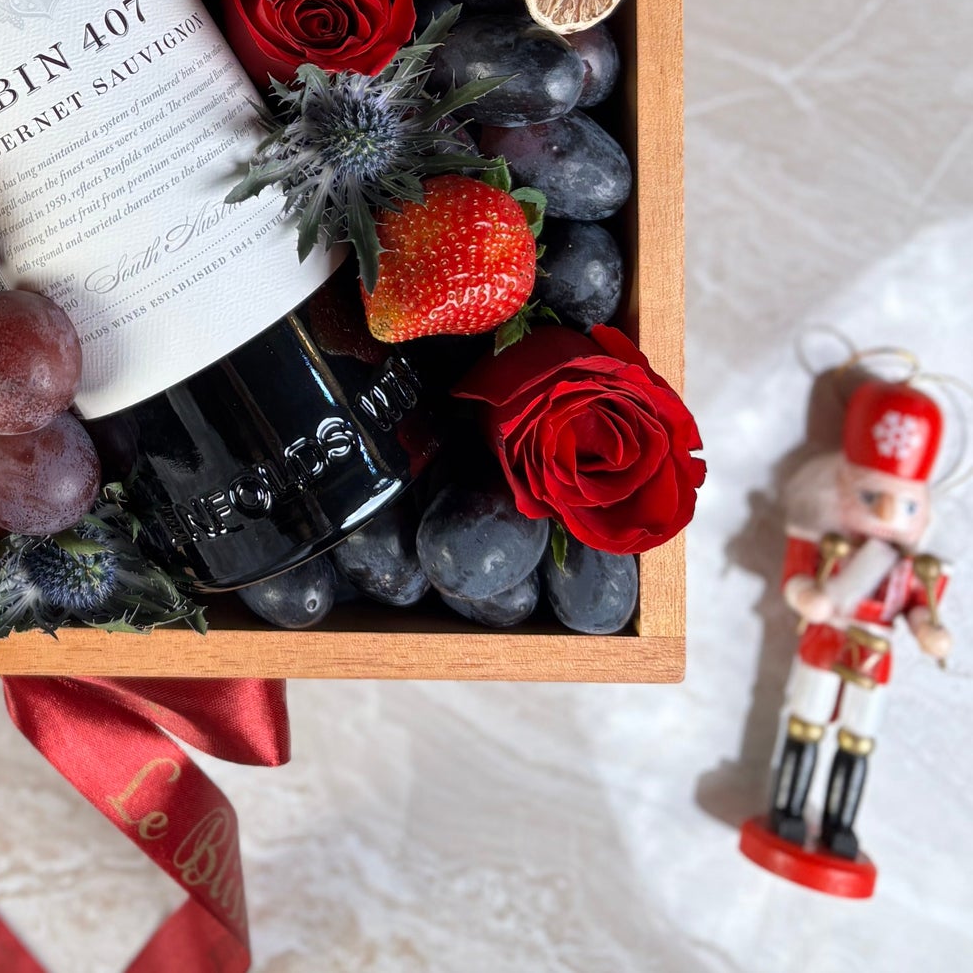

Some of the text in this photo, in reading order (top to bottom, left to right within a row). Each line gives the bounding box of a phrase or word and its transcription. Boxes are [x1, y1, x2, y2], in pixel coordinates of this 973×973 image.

[92, 14, 203, 96] SAUVIGNON
[1, 178, 17, 191] has
[16, 166, 39, 183] long
[37, 130, 91, 171] maintained
[99, 110, 130, 136] system
[136, 72, 181, 107] numbered
[8, 211, 35, 234] created
[45, 193, 72, 214] 1959,
[71, 175, 103, 199] reflects
[102, 149, 143, 180] Penfolds
[143, 121, 187, 155] meticulous
[186, 91, 229, 125] winemaking
[17, 186, 44, 205] where
[44, 177, 59, 191] the
[55, 160, 85, 187] finest
[85, 143, 115, 165] wines
[114, 128, 138, 147] were
[138, 107, 168, 133] stored.
[165, 99, 182, 113] The
[182, 72, 215, 104] renowned
[13, 233, 46, 254] sourcing
[44, 225, 59, 238] the
[58, 213, 77, 230] best
[78, 199, 106, 224] fruit
[101, 185, 126, 210] from
[127, 157, 170, 194] premium
[31, 242, 64, 268] regional
[65, 231, 83, 250] and
[83, 208, 123, 239] varietal
[123, 182, 170, 216] characters
[181, 165, 195, 180] the
[191, 136, 235, 169] distinctive
[84, 235, 163, 295] South
[111, 305, 148, 329] WINES
[149, 256, 227, 308] ESTABLISHED
[229, 237, 253, 258] 1844
[254, 213, 287, 240] SOUTH
[106, 758, 181, 841] Le
